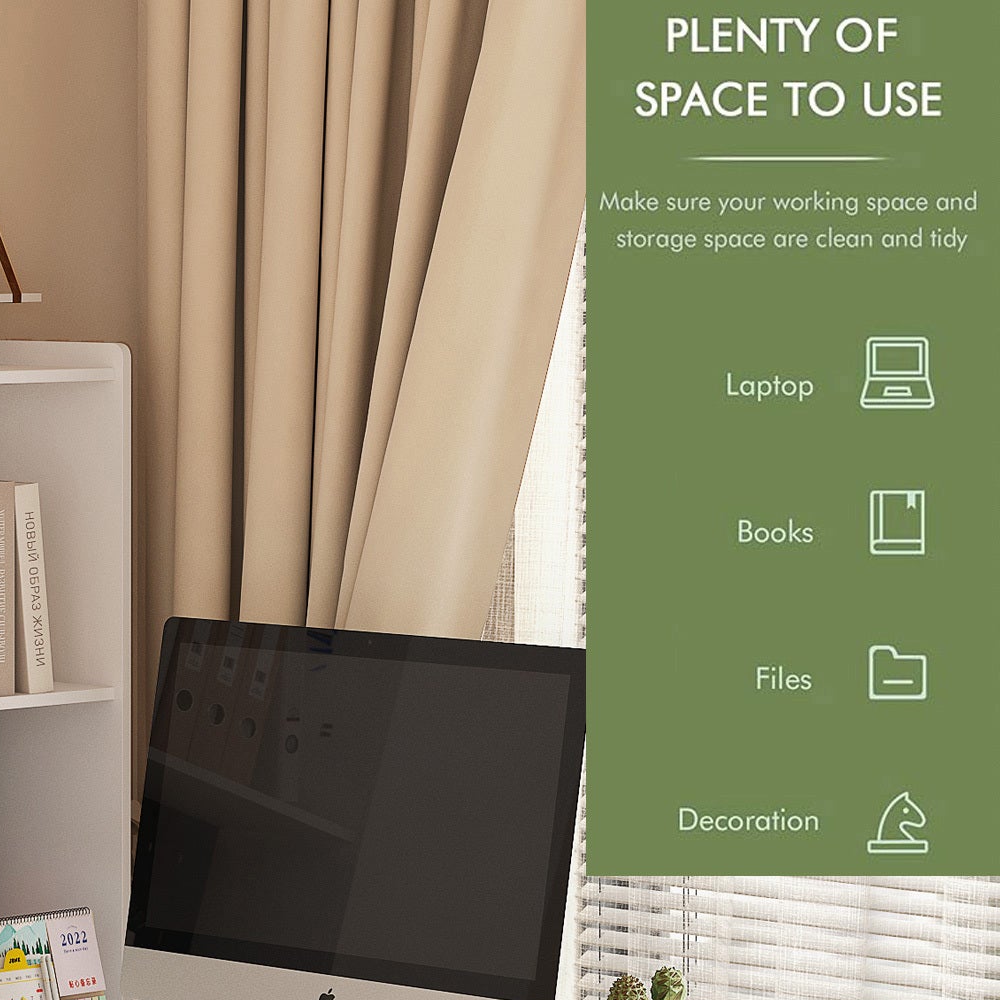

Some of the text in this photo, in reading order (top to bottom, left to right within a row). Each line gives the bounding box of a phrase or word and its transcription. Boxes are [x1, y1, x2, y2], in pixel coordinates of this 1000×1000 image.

[24, 511, 46, 667] НОВЫЙ ОБРАЗ ЖИЗНИ
[60, 931, 88, 947] 2022
